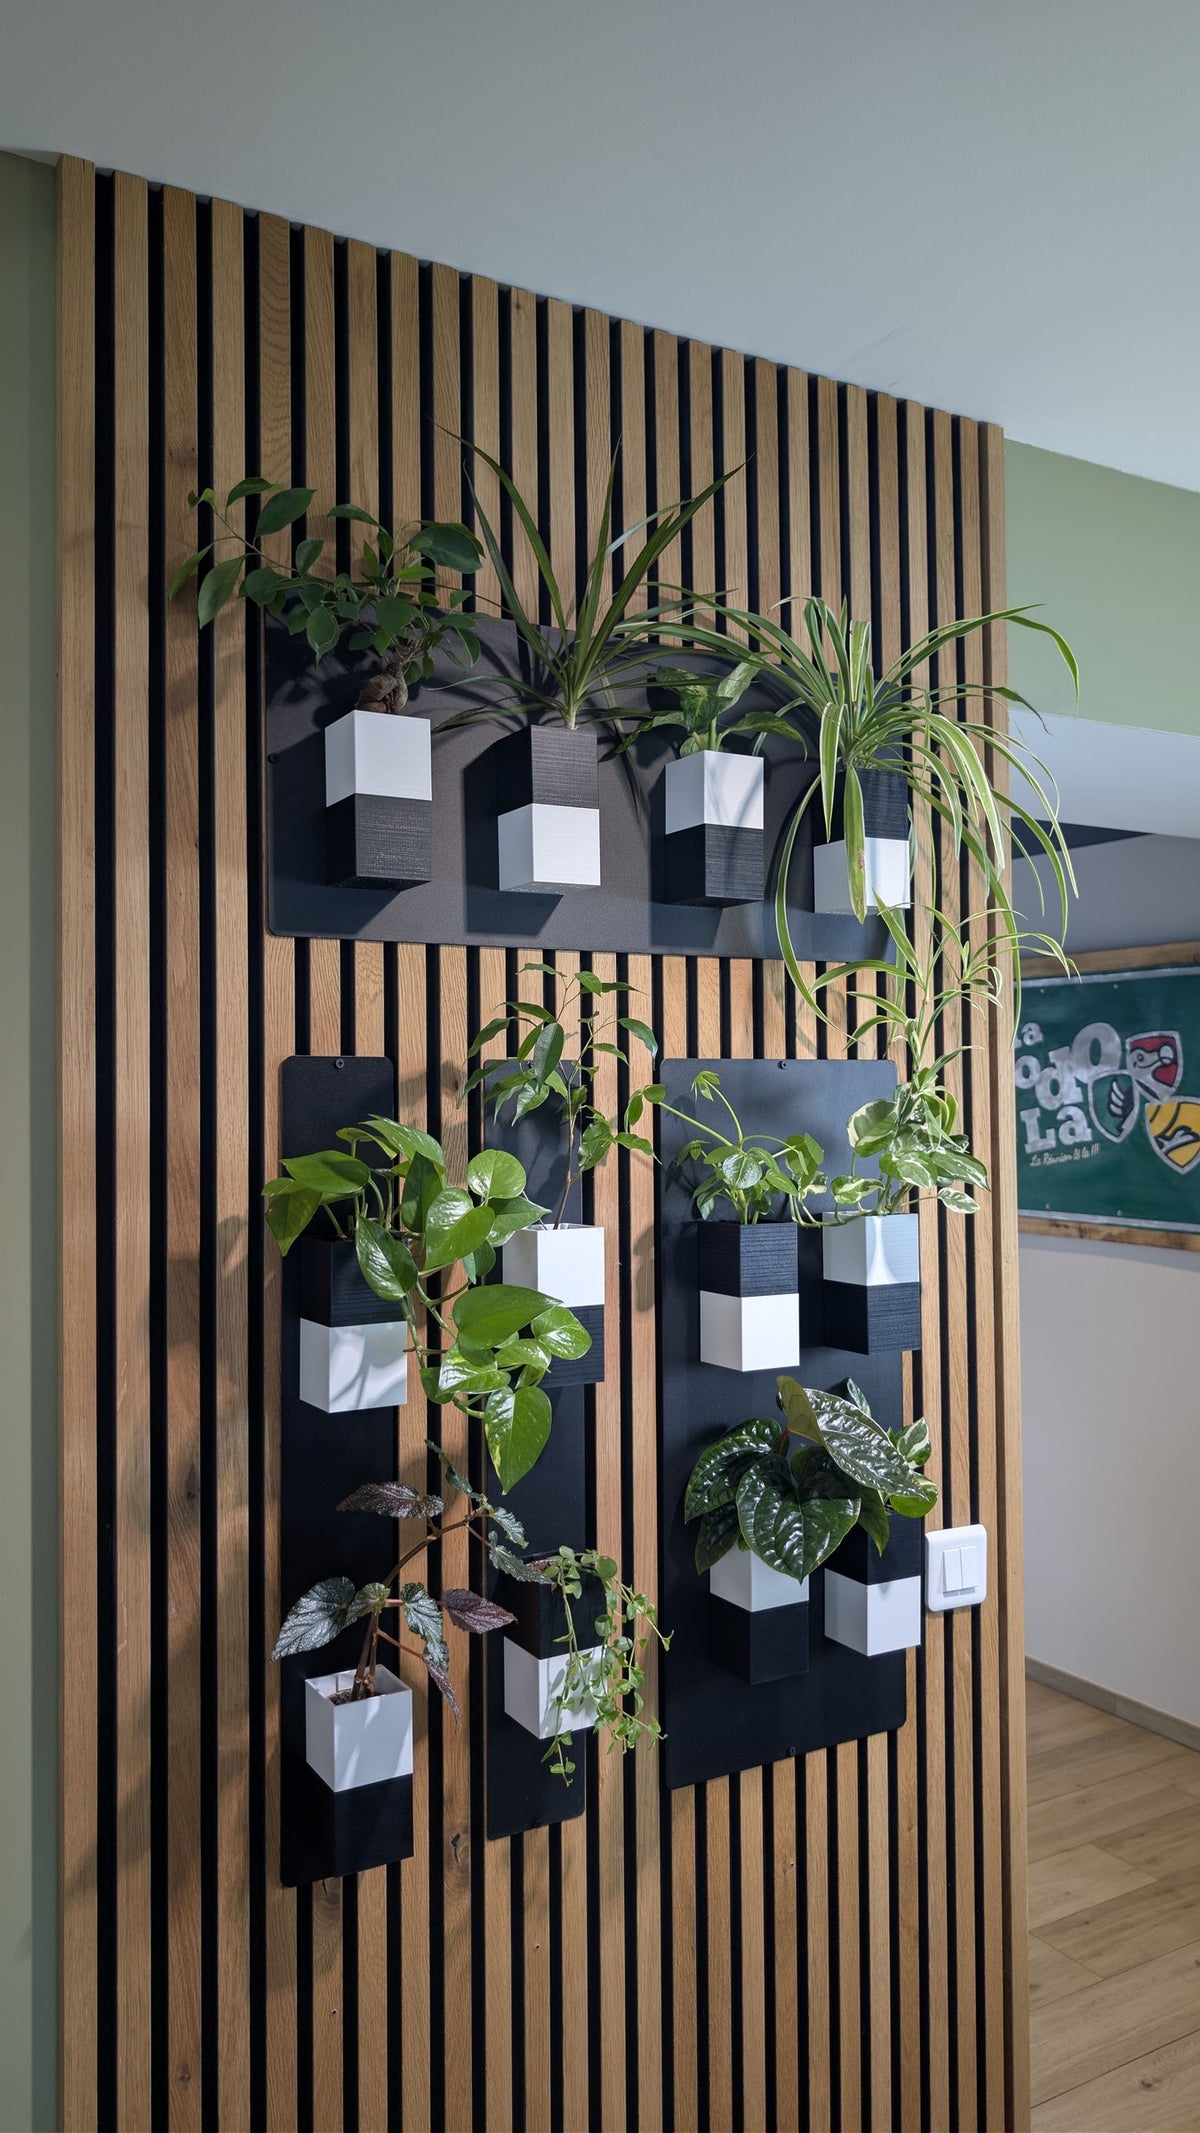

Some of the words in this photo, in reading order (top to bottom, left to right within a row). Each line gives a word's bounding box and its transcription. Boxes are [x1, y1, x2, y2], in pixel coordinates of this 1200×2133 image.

[1014, 1022, 1044, 1048] a
[1020, 1105, 1093, 1154] La
[1030, 1154, 1041, 1166] La
[1043, 1152, 1072, 1165] Réunion
